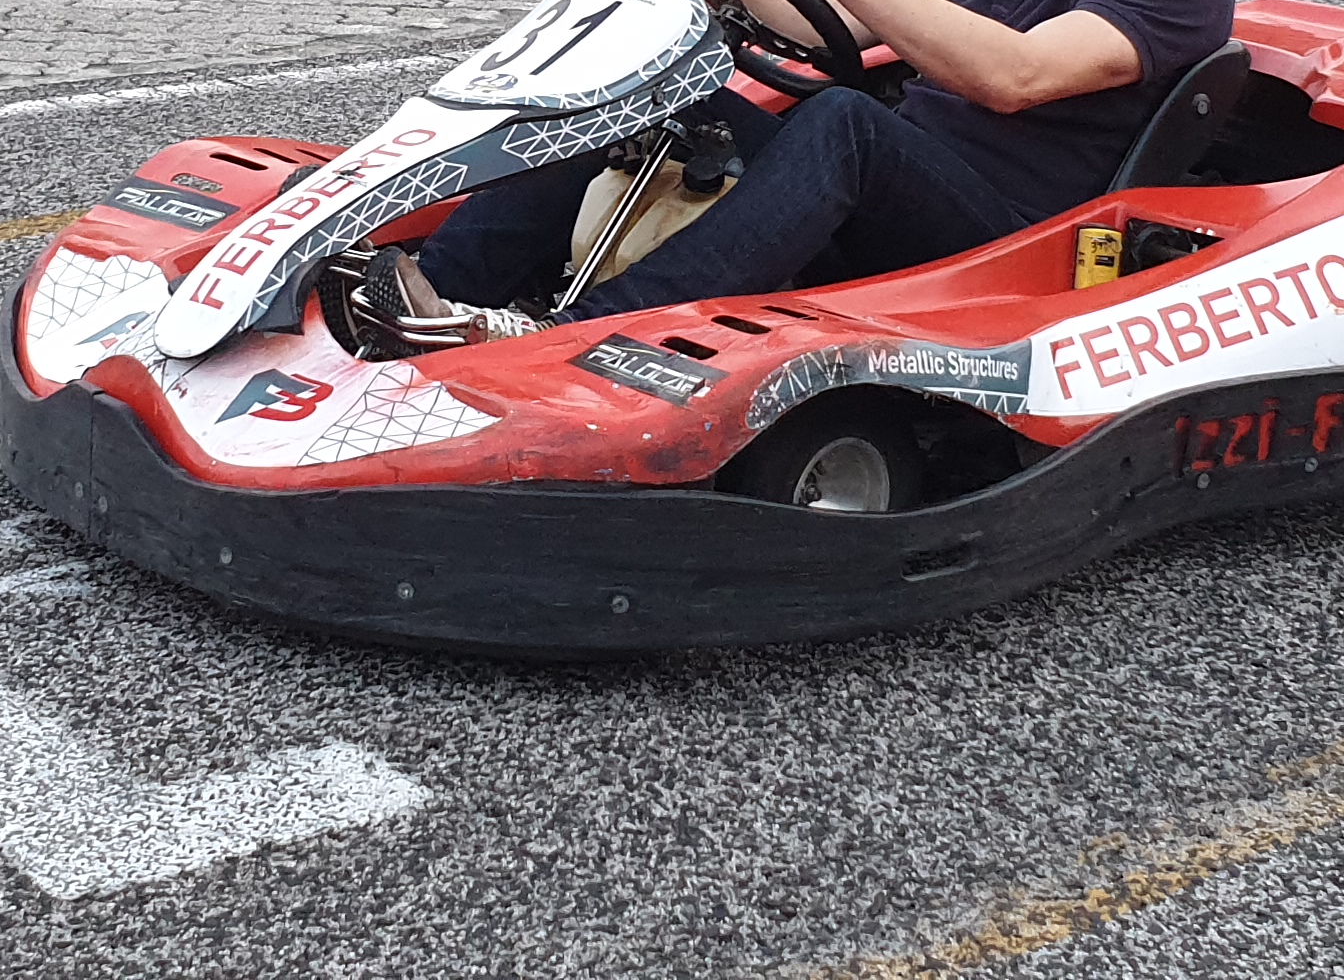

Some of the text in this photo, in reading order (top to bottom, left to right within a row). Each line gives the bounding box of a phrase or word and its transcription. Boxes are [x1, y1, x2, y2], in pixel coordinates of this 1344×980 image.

[114, 187, 227, 224] PALOCAR
[189, 128, 437, 310] FERBERTO
[868, 348, 1018, 381] Metallic Structures
